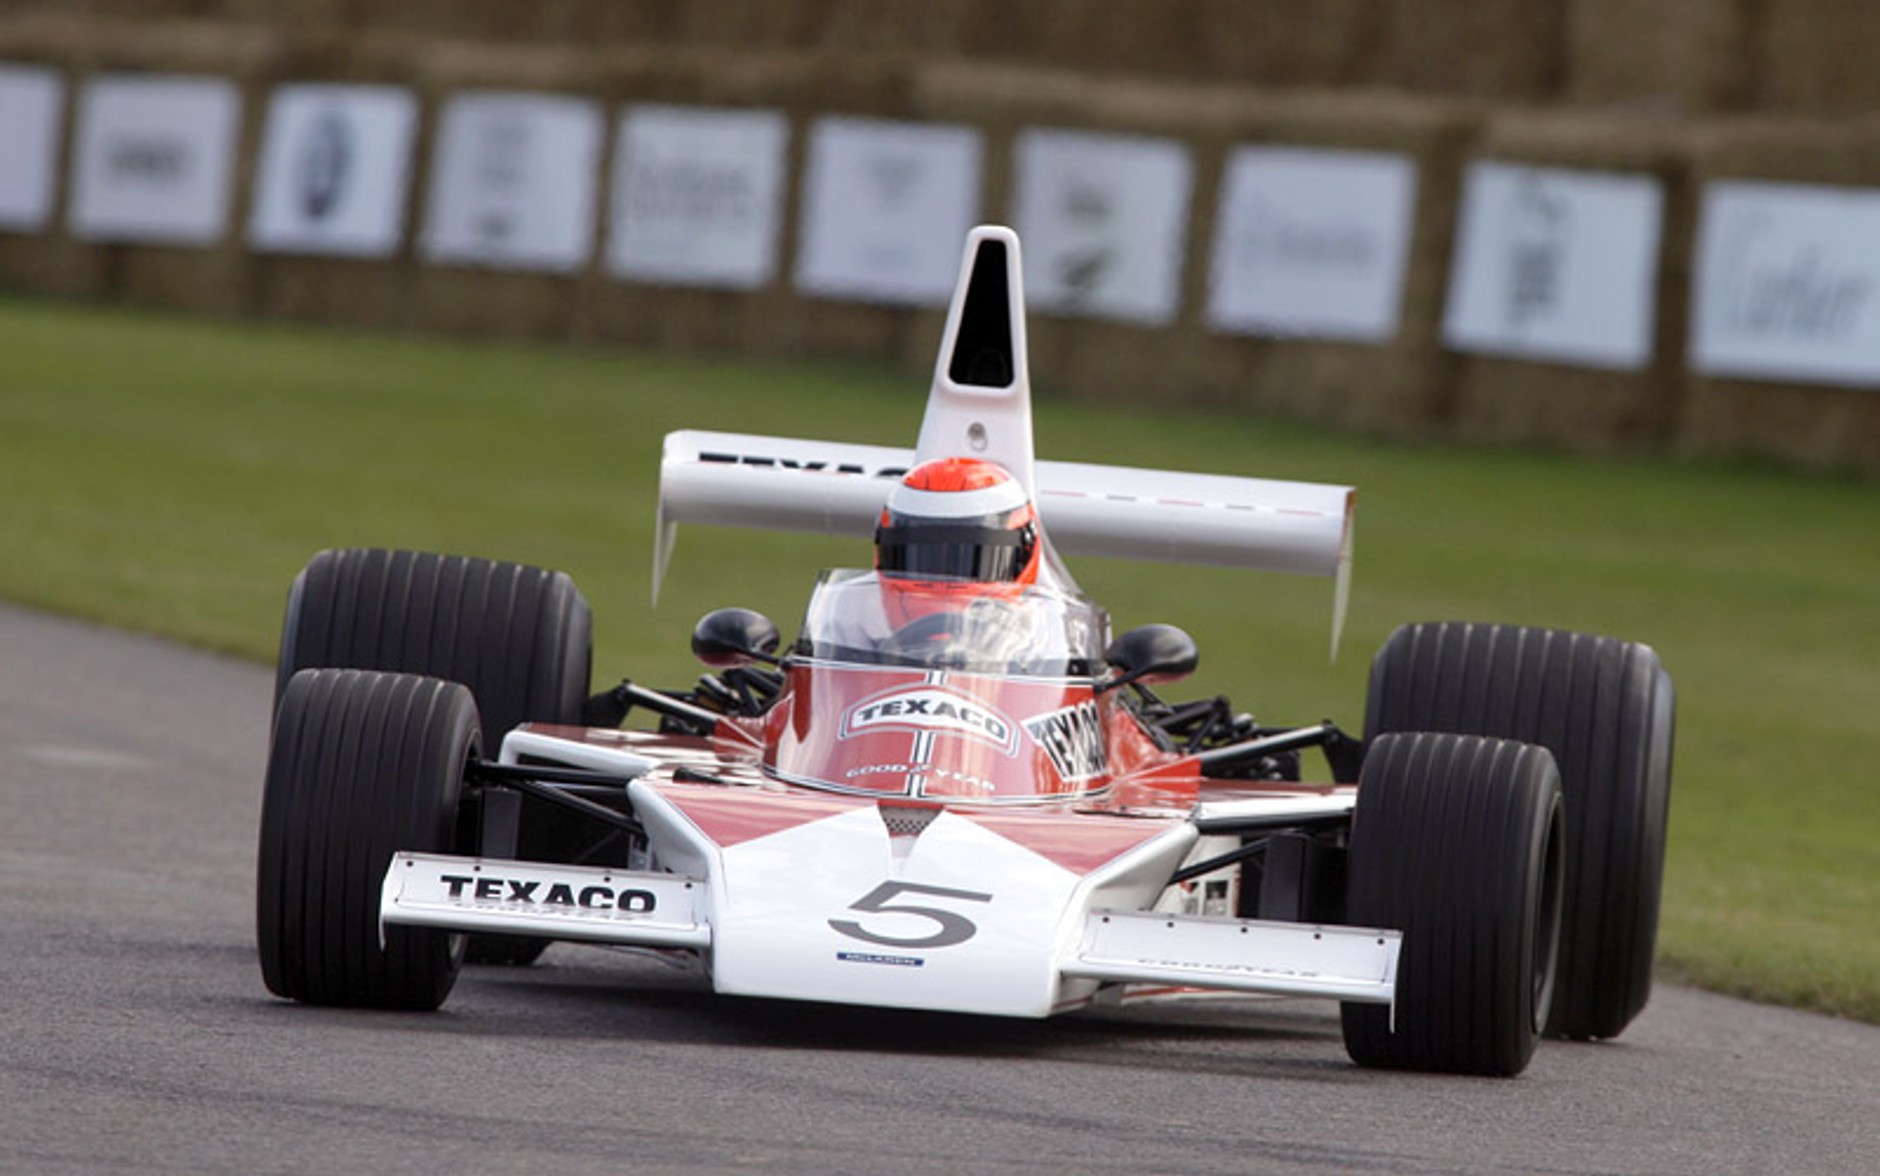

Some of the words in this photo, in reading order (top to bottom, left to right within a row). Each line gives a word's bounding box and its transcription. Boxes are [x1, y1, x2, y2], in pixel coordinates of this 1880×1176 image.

[857, 700, 1005, 740] TEXACO
[440, 875, 657, 914] TEXACO
[827, 880, 993, 949] 5
